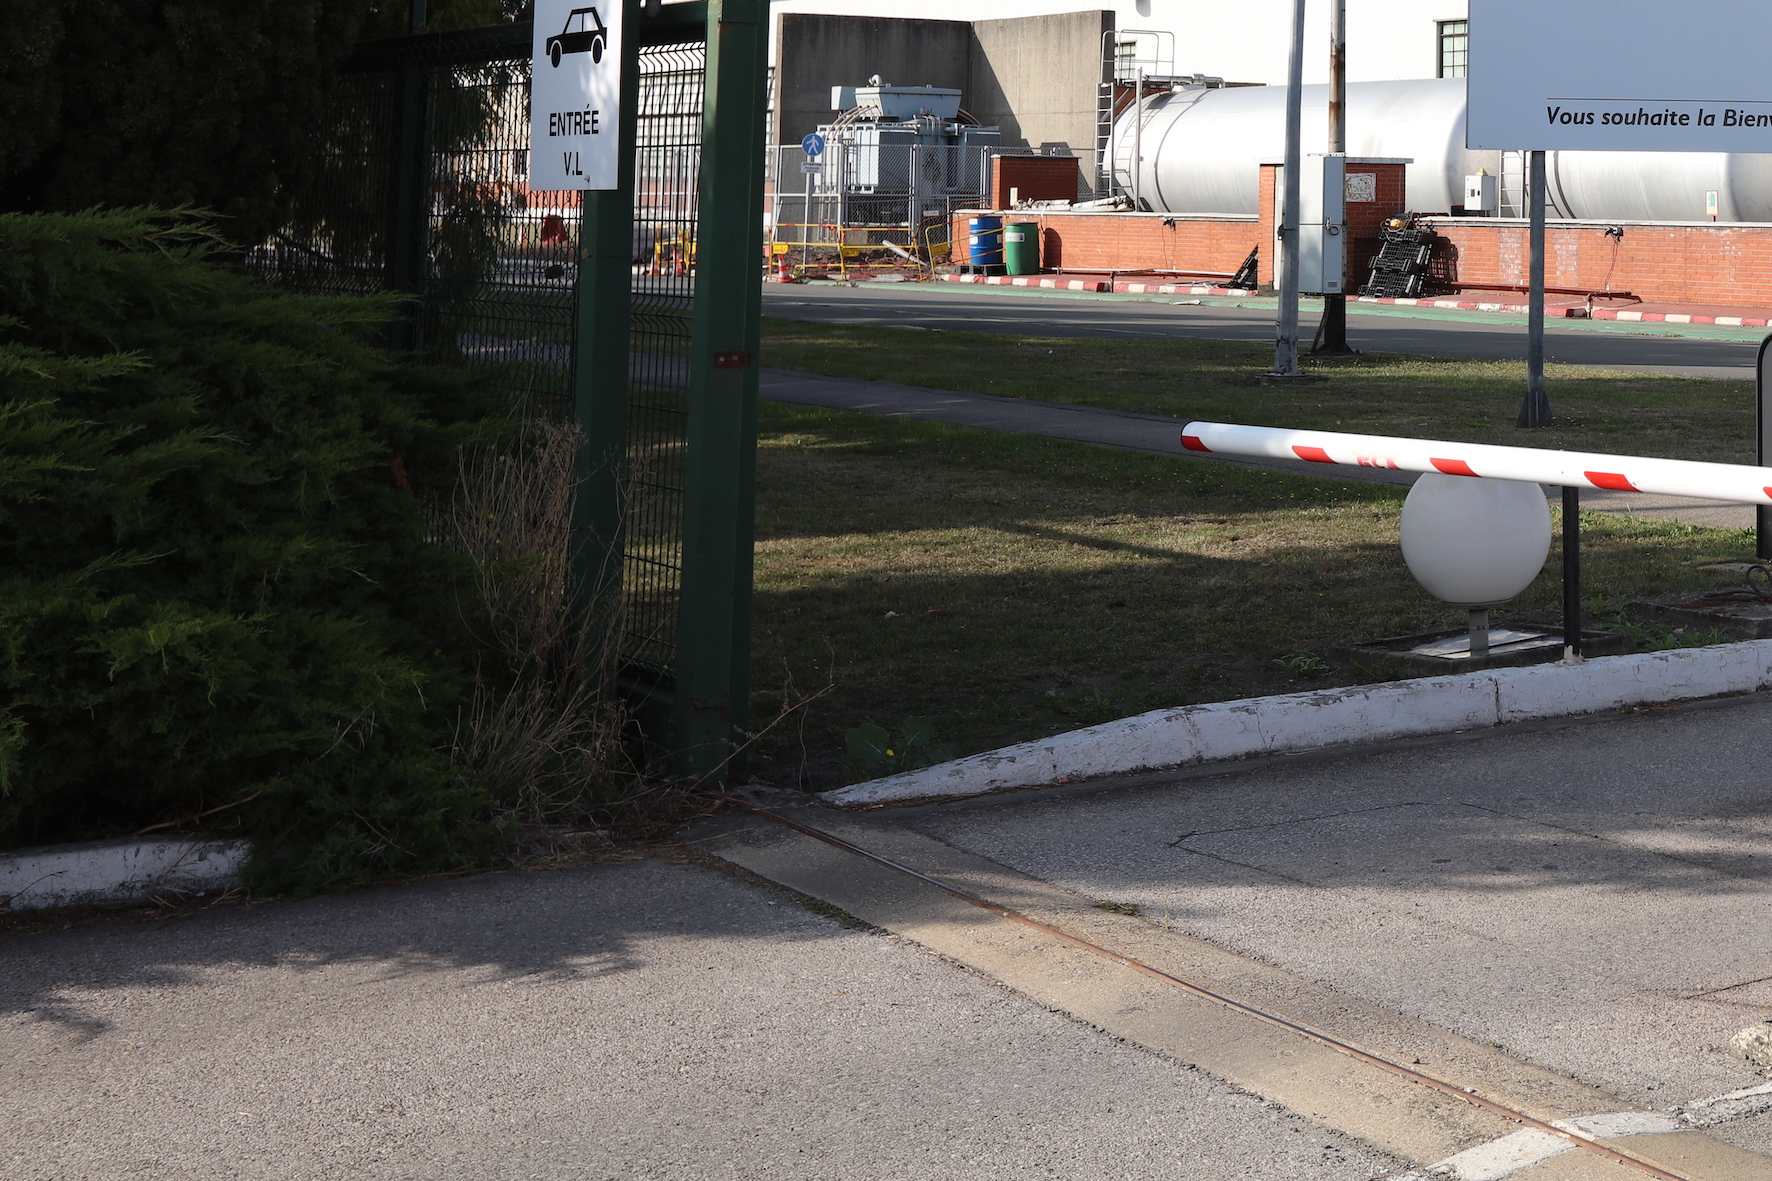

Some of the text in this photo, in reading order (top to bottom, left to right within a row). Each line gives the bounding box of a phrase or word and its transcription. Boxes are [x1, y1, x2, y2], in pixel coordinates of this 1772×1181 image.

[549, 104, 599, 137] ENTRÉE
[1546, 106, 1595, 125] Vous
[1601, 107, 1690, 127] souhaite
[1697, 108, 1716, 127] la
[563, 151, 583, 176] V.L
